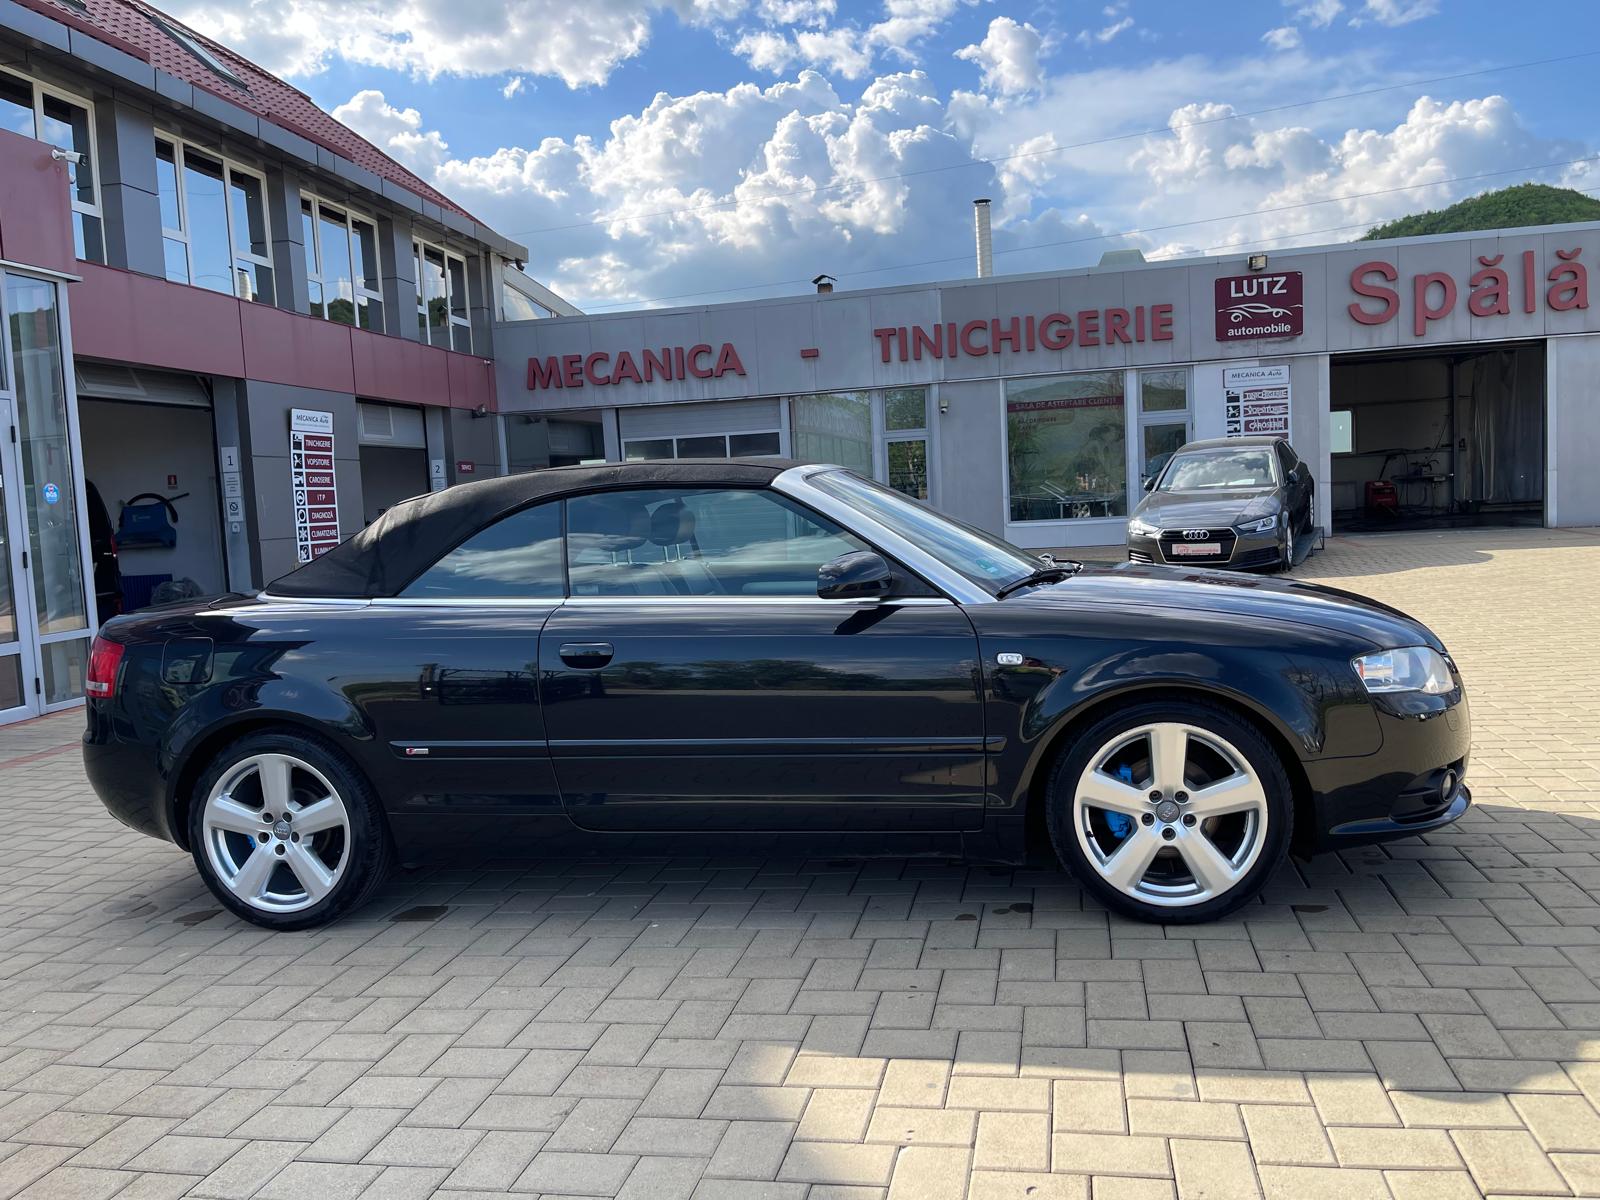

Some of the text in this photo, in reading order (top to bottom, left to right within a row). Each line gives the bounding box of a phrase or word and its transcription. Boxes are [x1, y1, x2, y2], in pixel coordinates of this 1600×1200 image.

[1230, 276, 1287, 298] LUTZ
[1227, 322, 1291, 337] automobile
[526, 342, 747, 391] MECANICA
[874, 303, 1173, 363] TINICHIGERIE
[1231, 371, 1266, 379] MECANICA
[295, 414, 319, 423] MECANICA
[305, 439, 331, 448] TINICHIGERIE
[228, 455, 234, 466] 1
[306, 458, 330, 466] VOPSITORIE
[435, 465, 440, 473] 2
[308, 476, 331, 484] CAROSERIE
[311, 529, 337, 538] CLIMATIZARE
